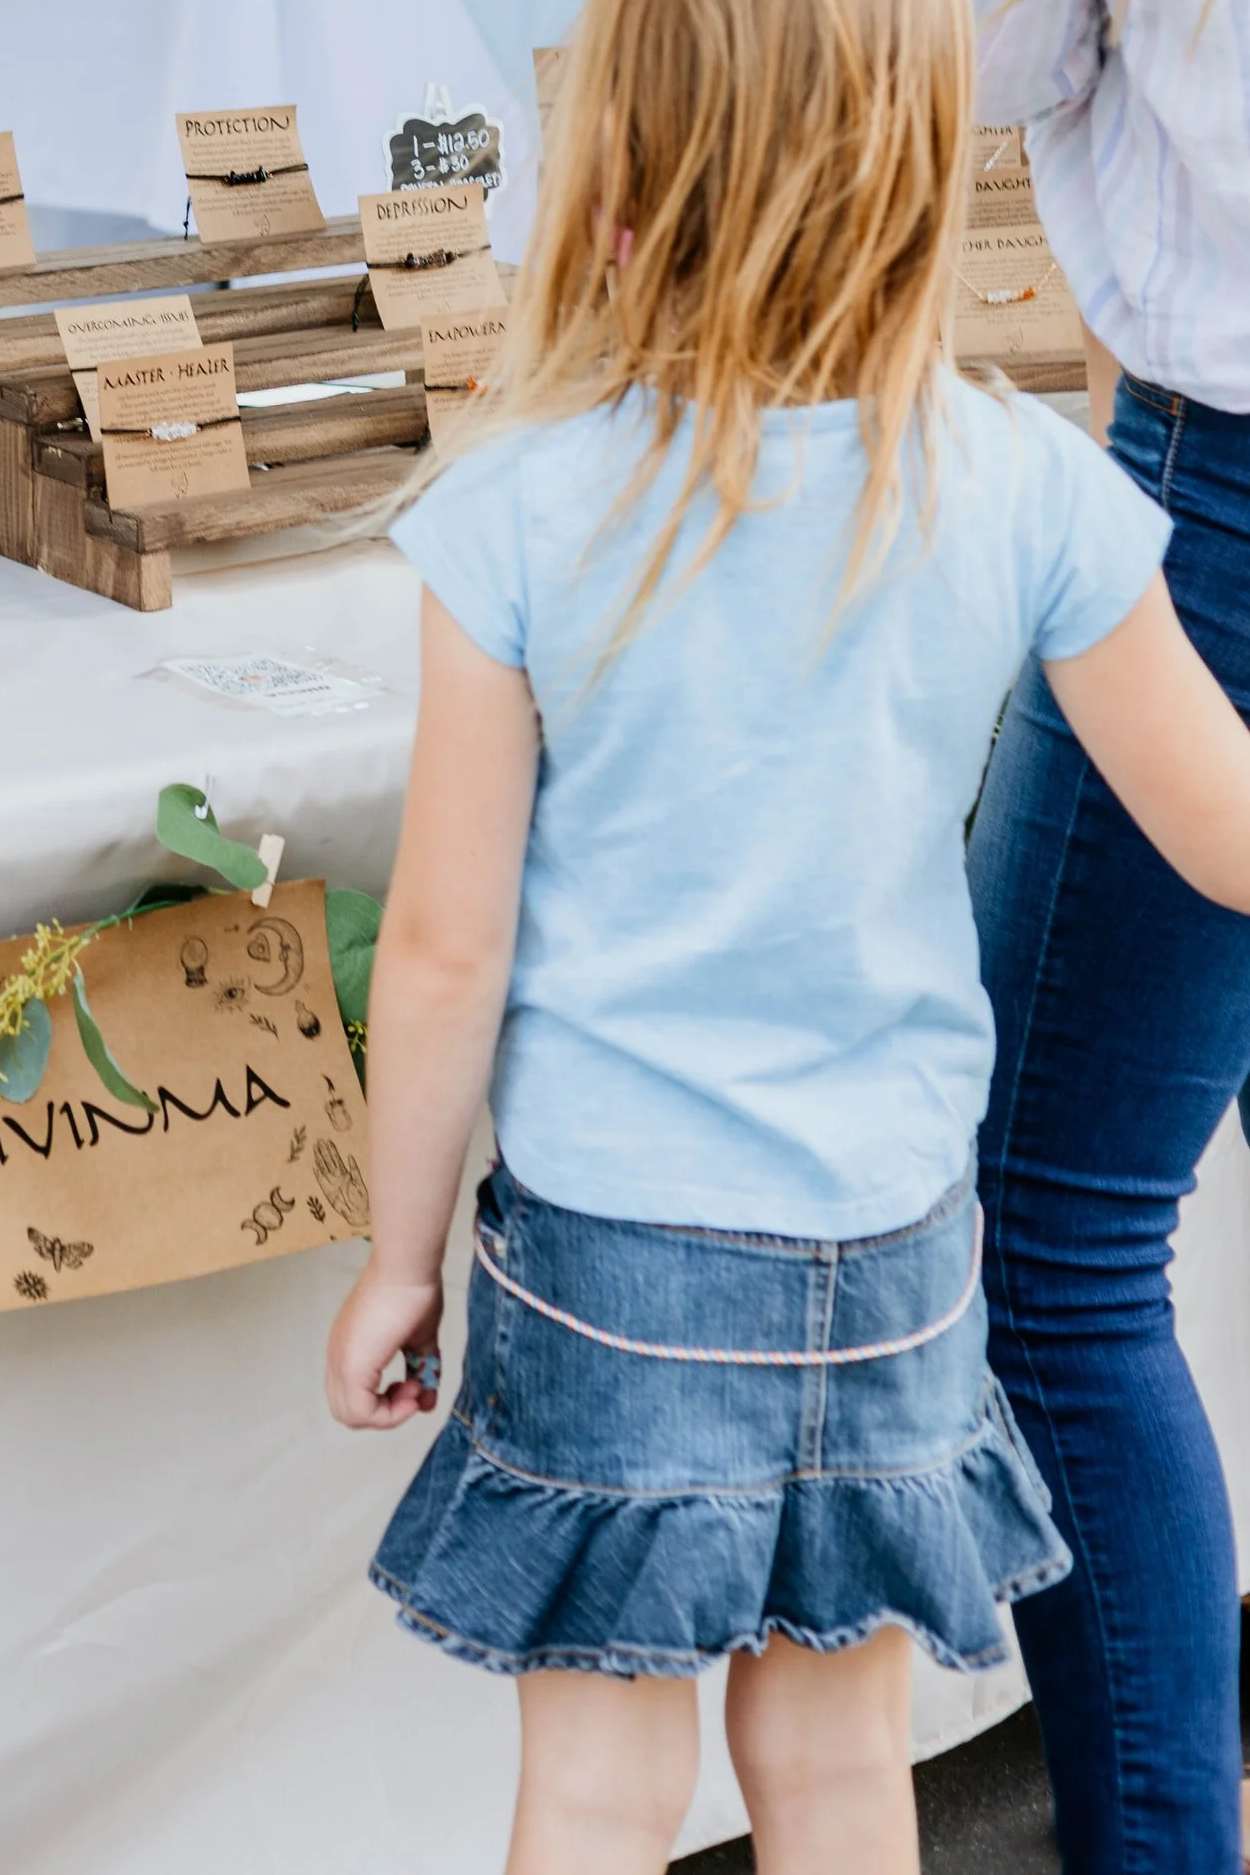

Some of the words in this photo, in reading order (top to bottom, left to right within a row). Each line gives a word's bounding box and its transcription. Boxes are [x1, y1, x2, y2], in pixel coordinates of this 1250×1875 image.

[185, 116, 290, 138] PROTECTION
[375, 196, 468, 221] DEPRESSION
[68, 314, 156, 335] OVERCOMING
[103, 368, 165, 391] MASTER
[177, 358, 230, 380] HEALER
